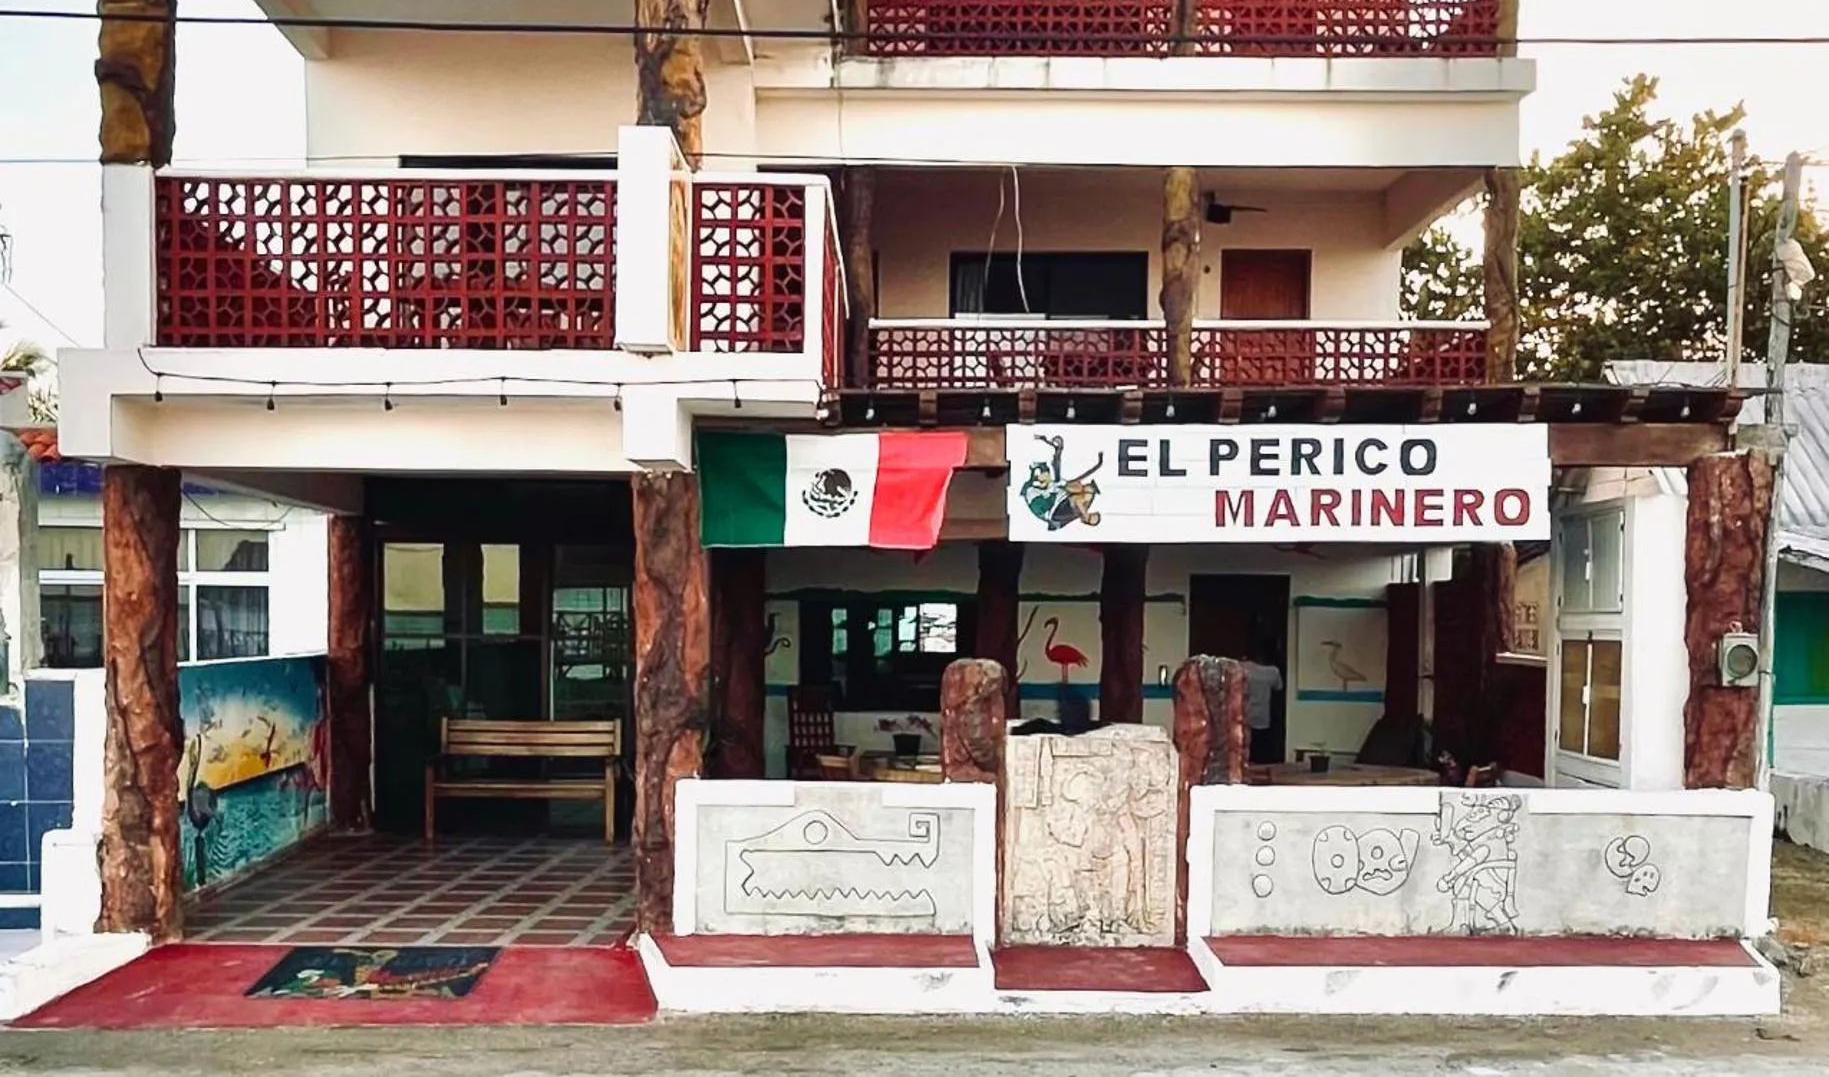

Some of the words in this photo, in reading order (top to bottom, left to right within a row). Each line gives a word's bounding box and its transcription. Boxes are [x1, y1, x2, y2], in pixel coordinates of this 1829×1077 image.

[1117, 438, 1187, 478] EL
[1209, 437, 1437, 477] PERICO
[1215, 488, 1531, 528] MARINERO
